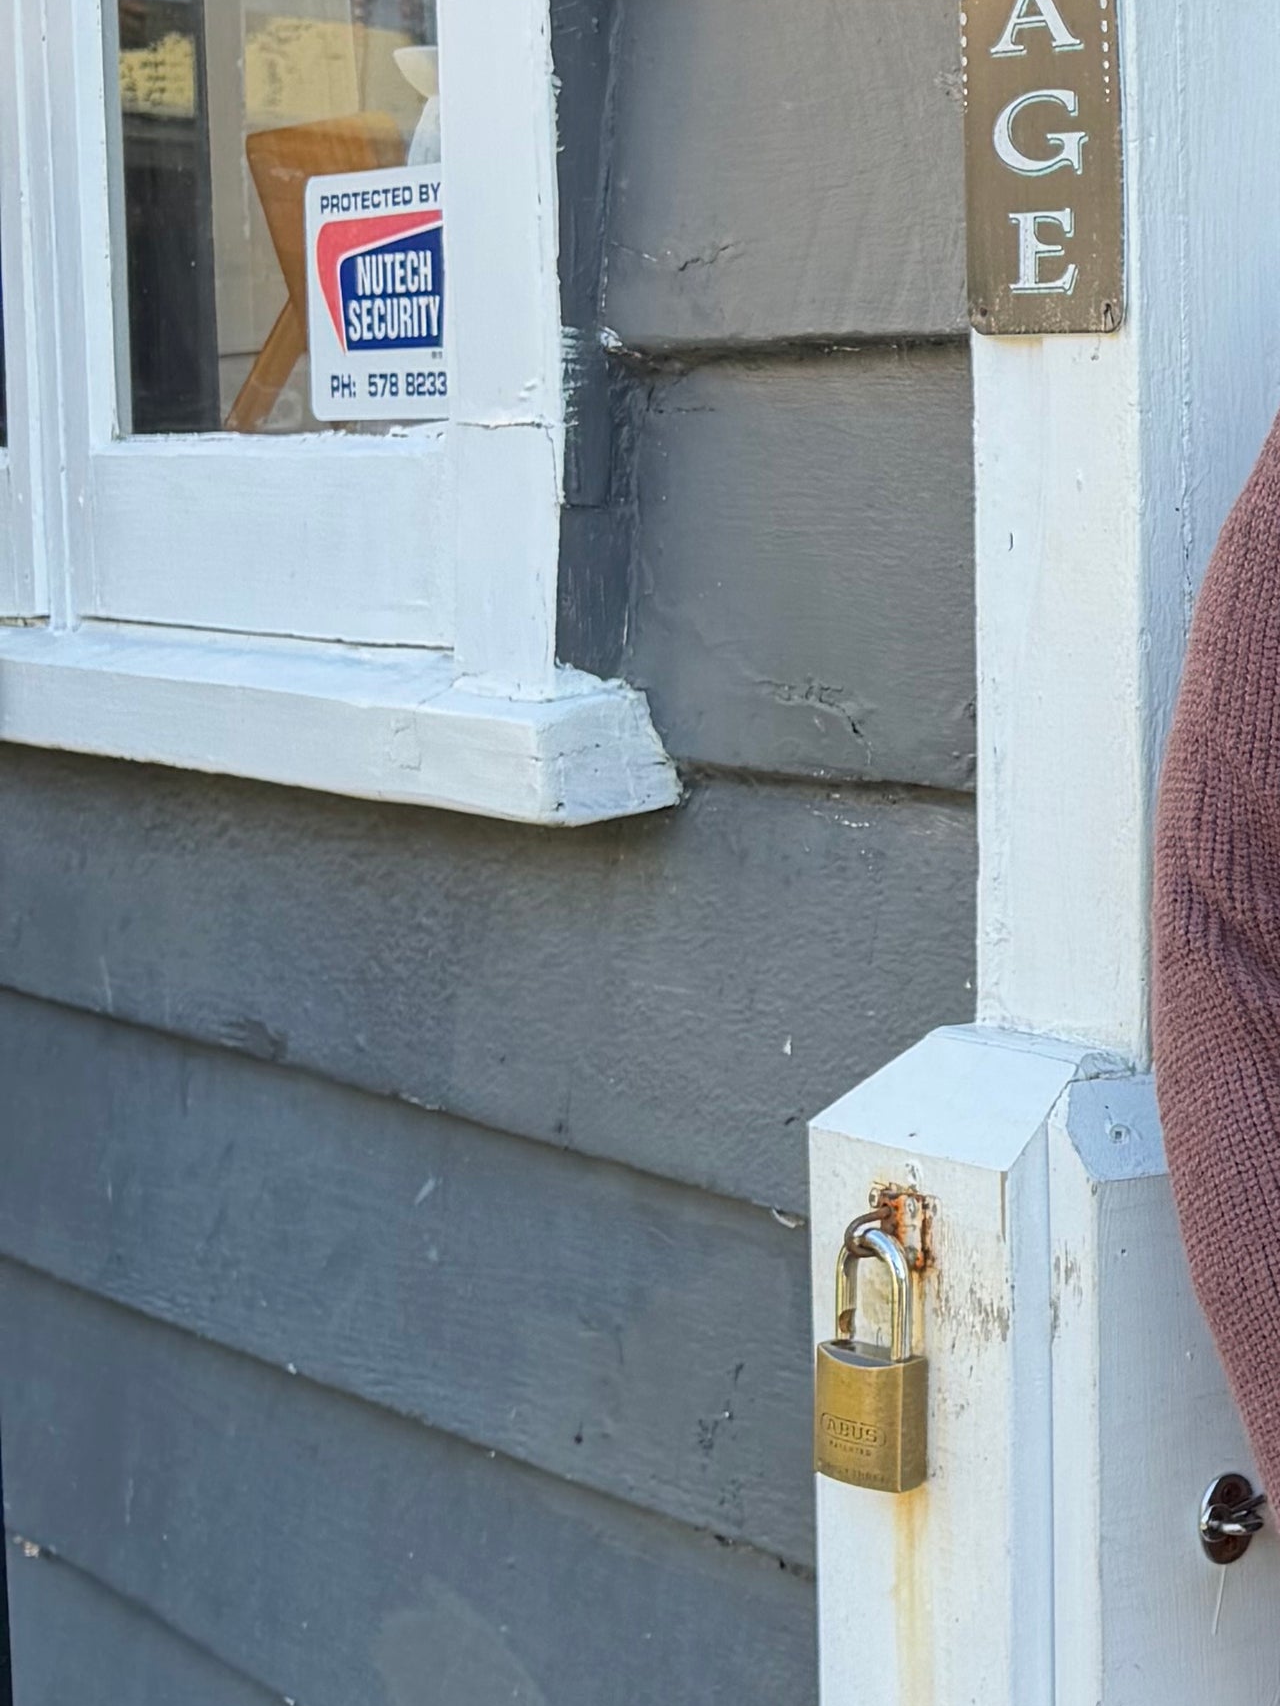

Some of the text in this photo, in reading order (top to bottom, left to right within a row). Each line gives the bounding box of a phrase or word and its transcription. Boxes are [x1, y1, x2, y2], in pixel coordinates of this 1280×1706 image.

[320, 182, 441, 214] PROTECTED BY
[356, 250, 432, 297] NUTECH
[348, 295, 440, 342] SECURITY
[330, 371, 447, 398] PH: 578 8233
[826, 1417, 878, 1443] ABUS
